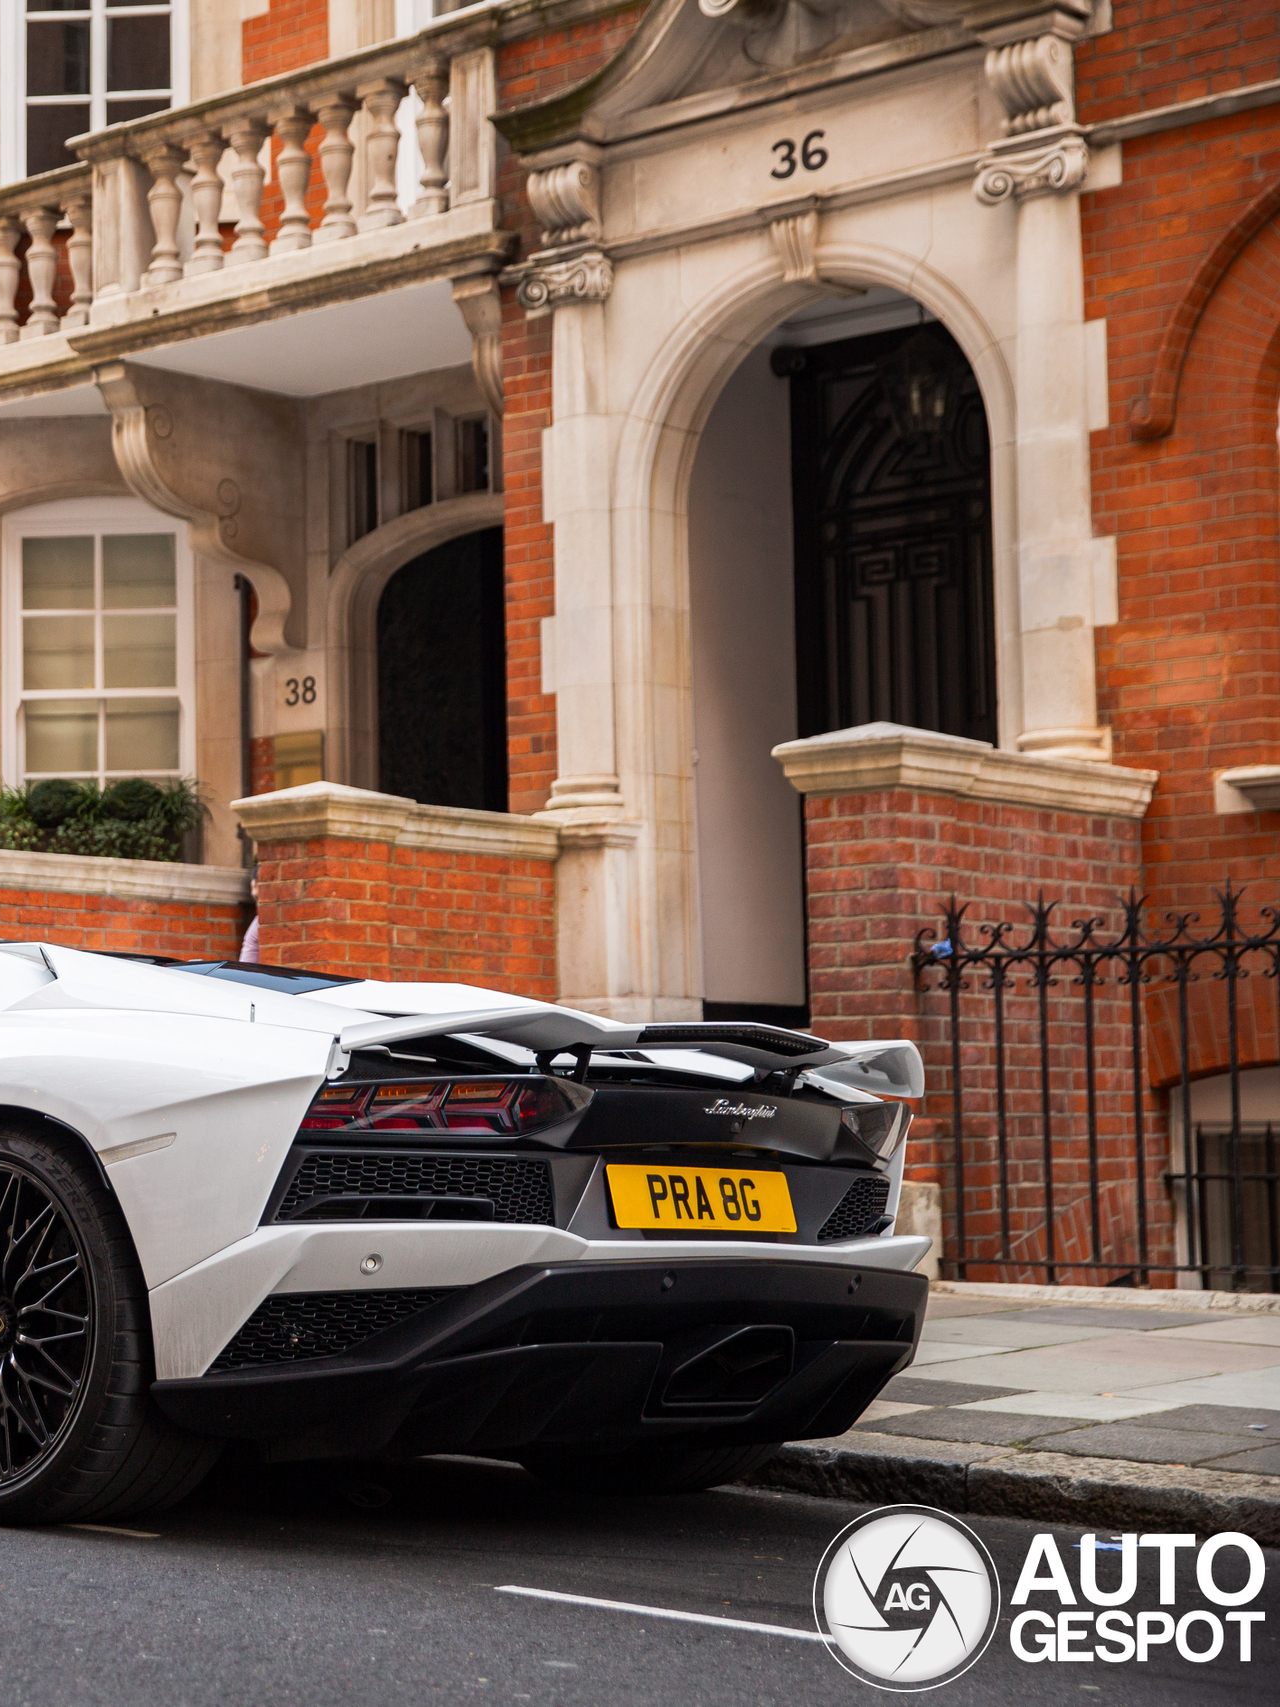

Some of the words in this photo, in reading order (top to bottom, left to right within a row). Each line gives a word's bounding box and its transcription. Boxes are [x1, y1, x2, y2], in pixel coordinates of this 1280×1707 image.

[771, 129, 829, 179] 36
[285, 675, 317, 706] 38
[703, 1098, 777, 1120] Lamborghini
[30, 1152, 47, 1162] P
[45, 1164, 91, 1223] ZERO
[646, 1174, 715, 1220] PRA
[718, 1177, 762, 1221] 8G
